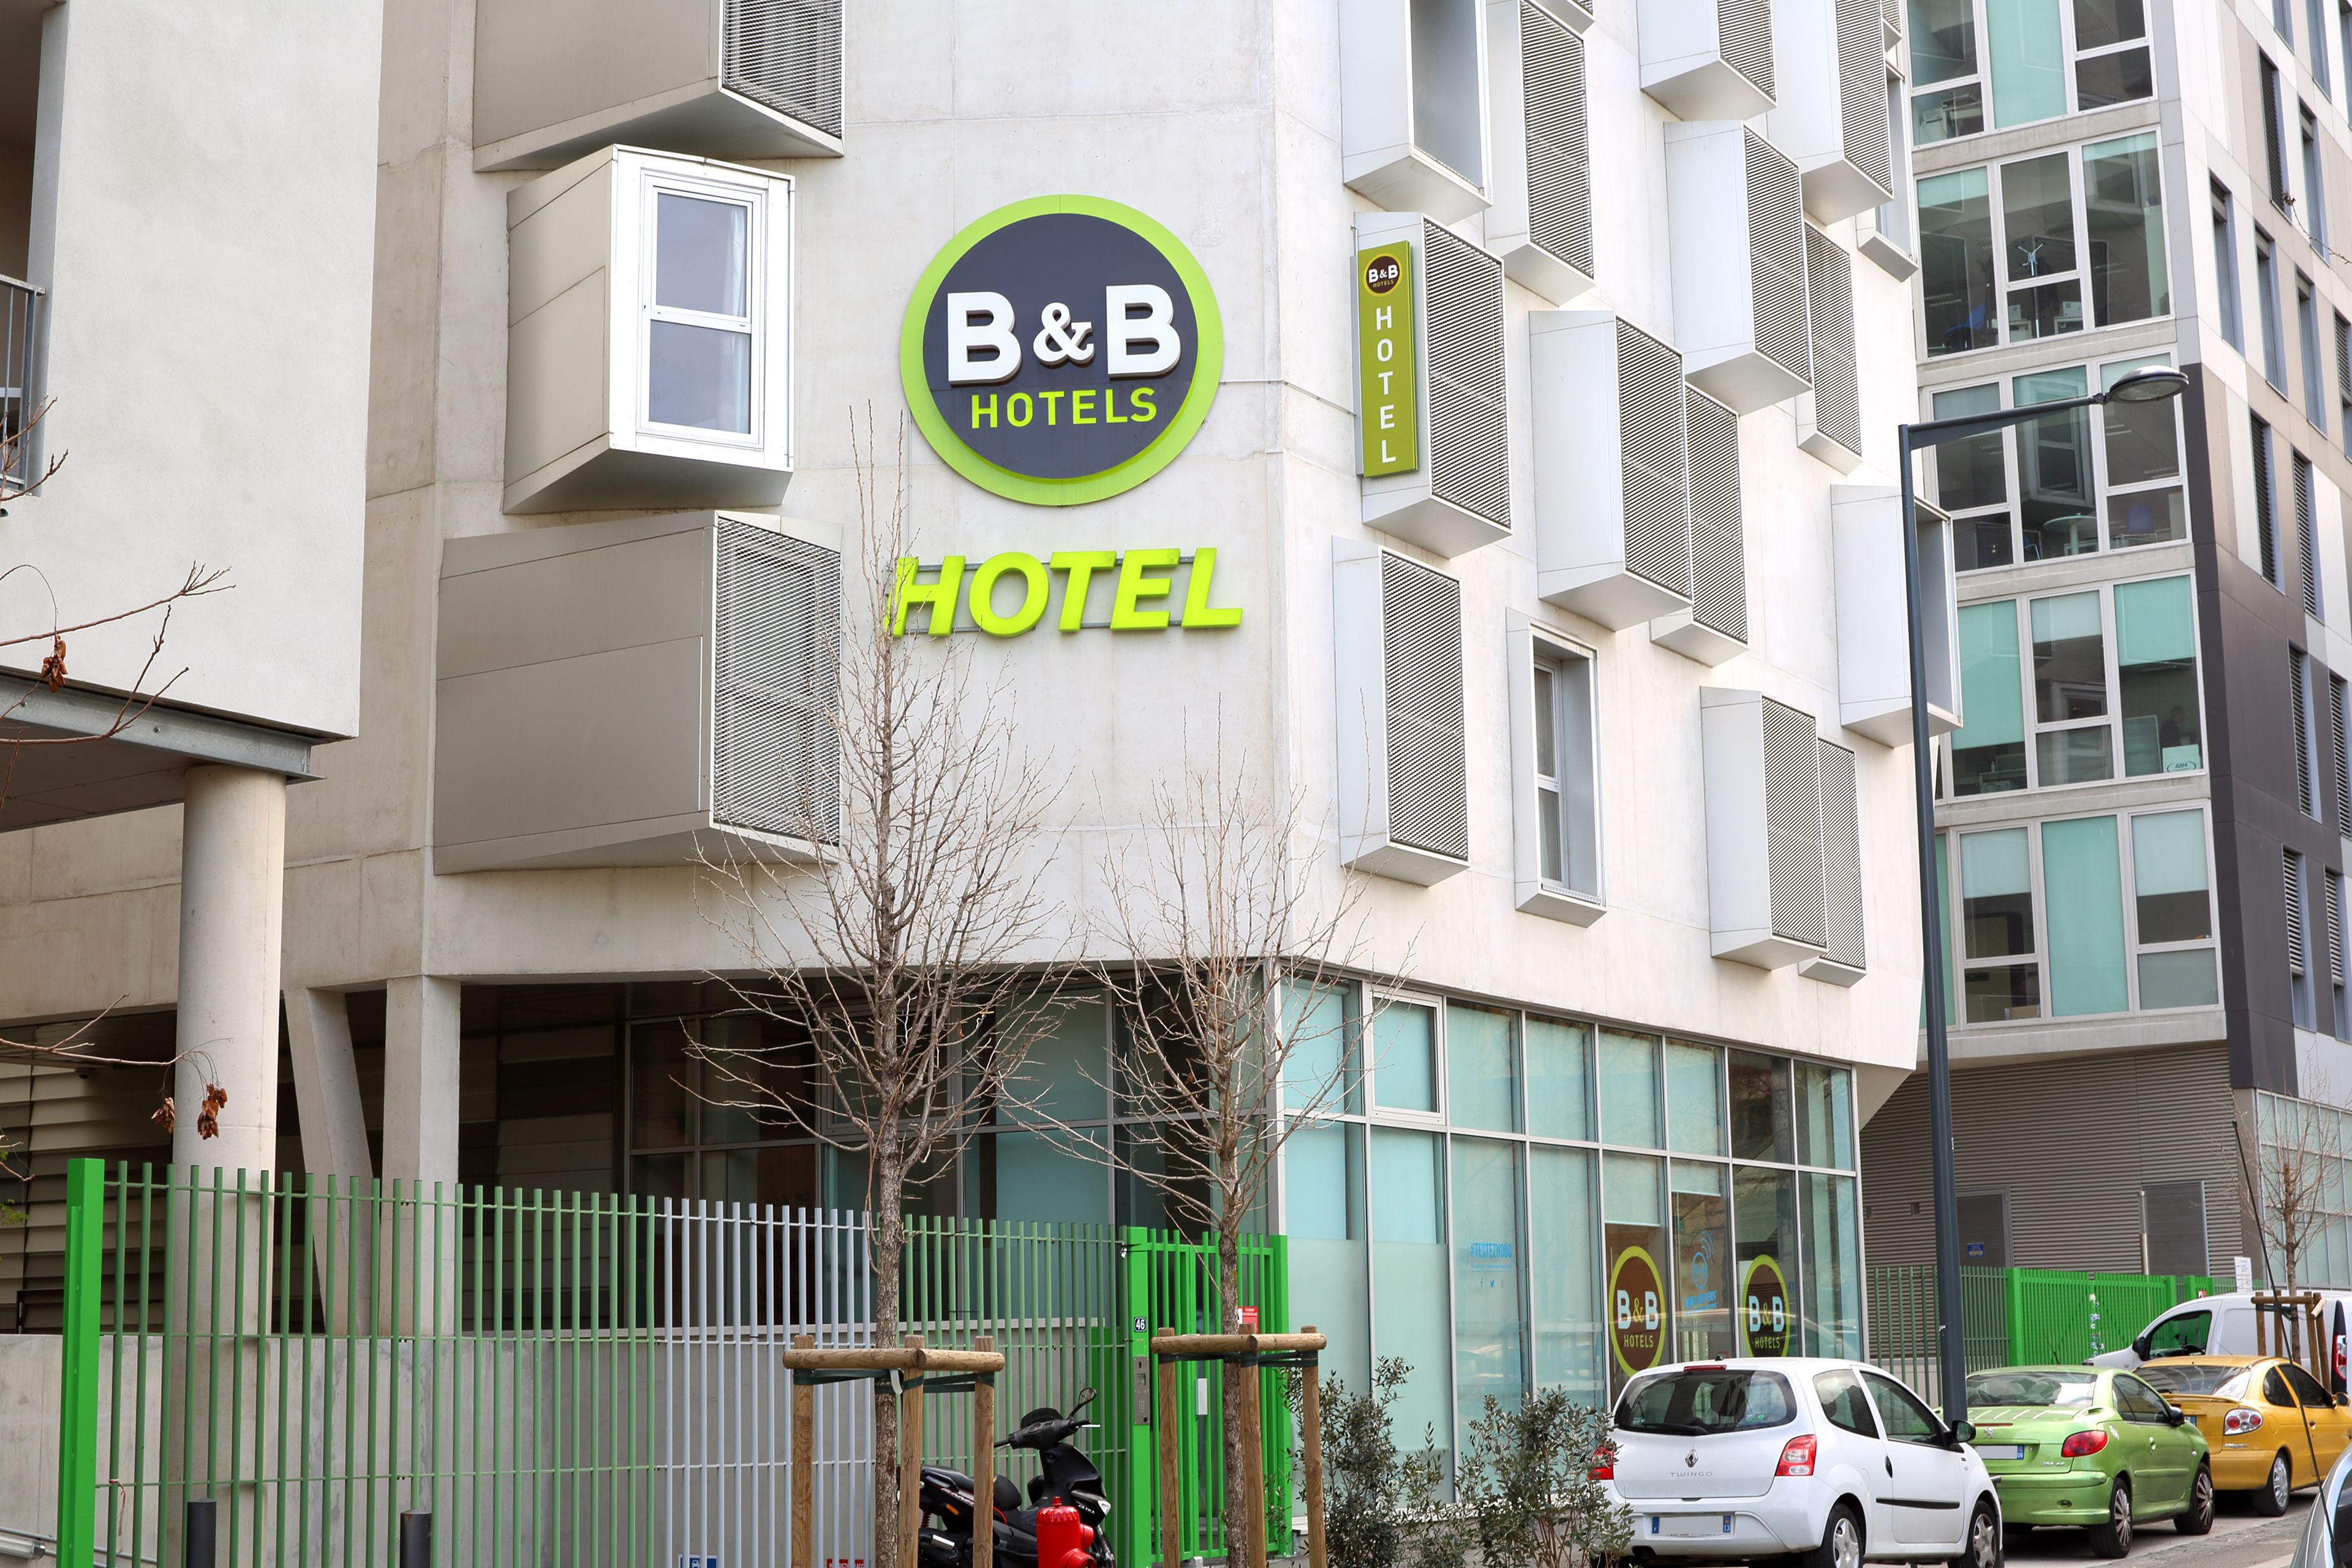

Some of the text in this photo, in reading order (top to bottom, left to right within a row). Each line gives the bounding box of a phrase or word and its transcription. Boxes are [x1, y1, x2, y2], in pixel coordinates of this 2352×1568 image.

[1368, 265, 1398, 283] B&B
[1373, 279, 1394, 288] HOTELS
[947, 284, 1181, 385] B&B
[1376, 306, 1396, 464] HOTEL
[971, 386, 1157, 429] HOTELS
[885, 547, 1243, 638] HOTEL
[1471, 1242, 1512, 1258] #TESTEZNOUS
[1617, 1290, 1659, 1330] B&B
[1749, 1295, 1785, 1332] B&B
[1136, 1319, 1145, 1330] 46
[1624, 1335, 1654, 1348] HOTELS
[1755, 1336, 1780, 1349] HOTELS
